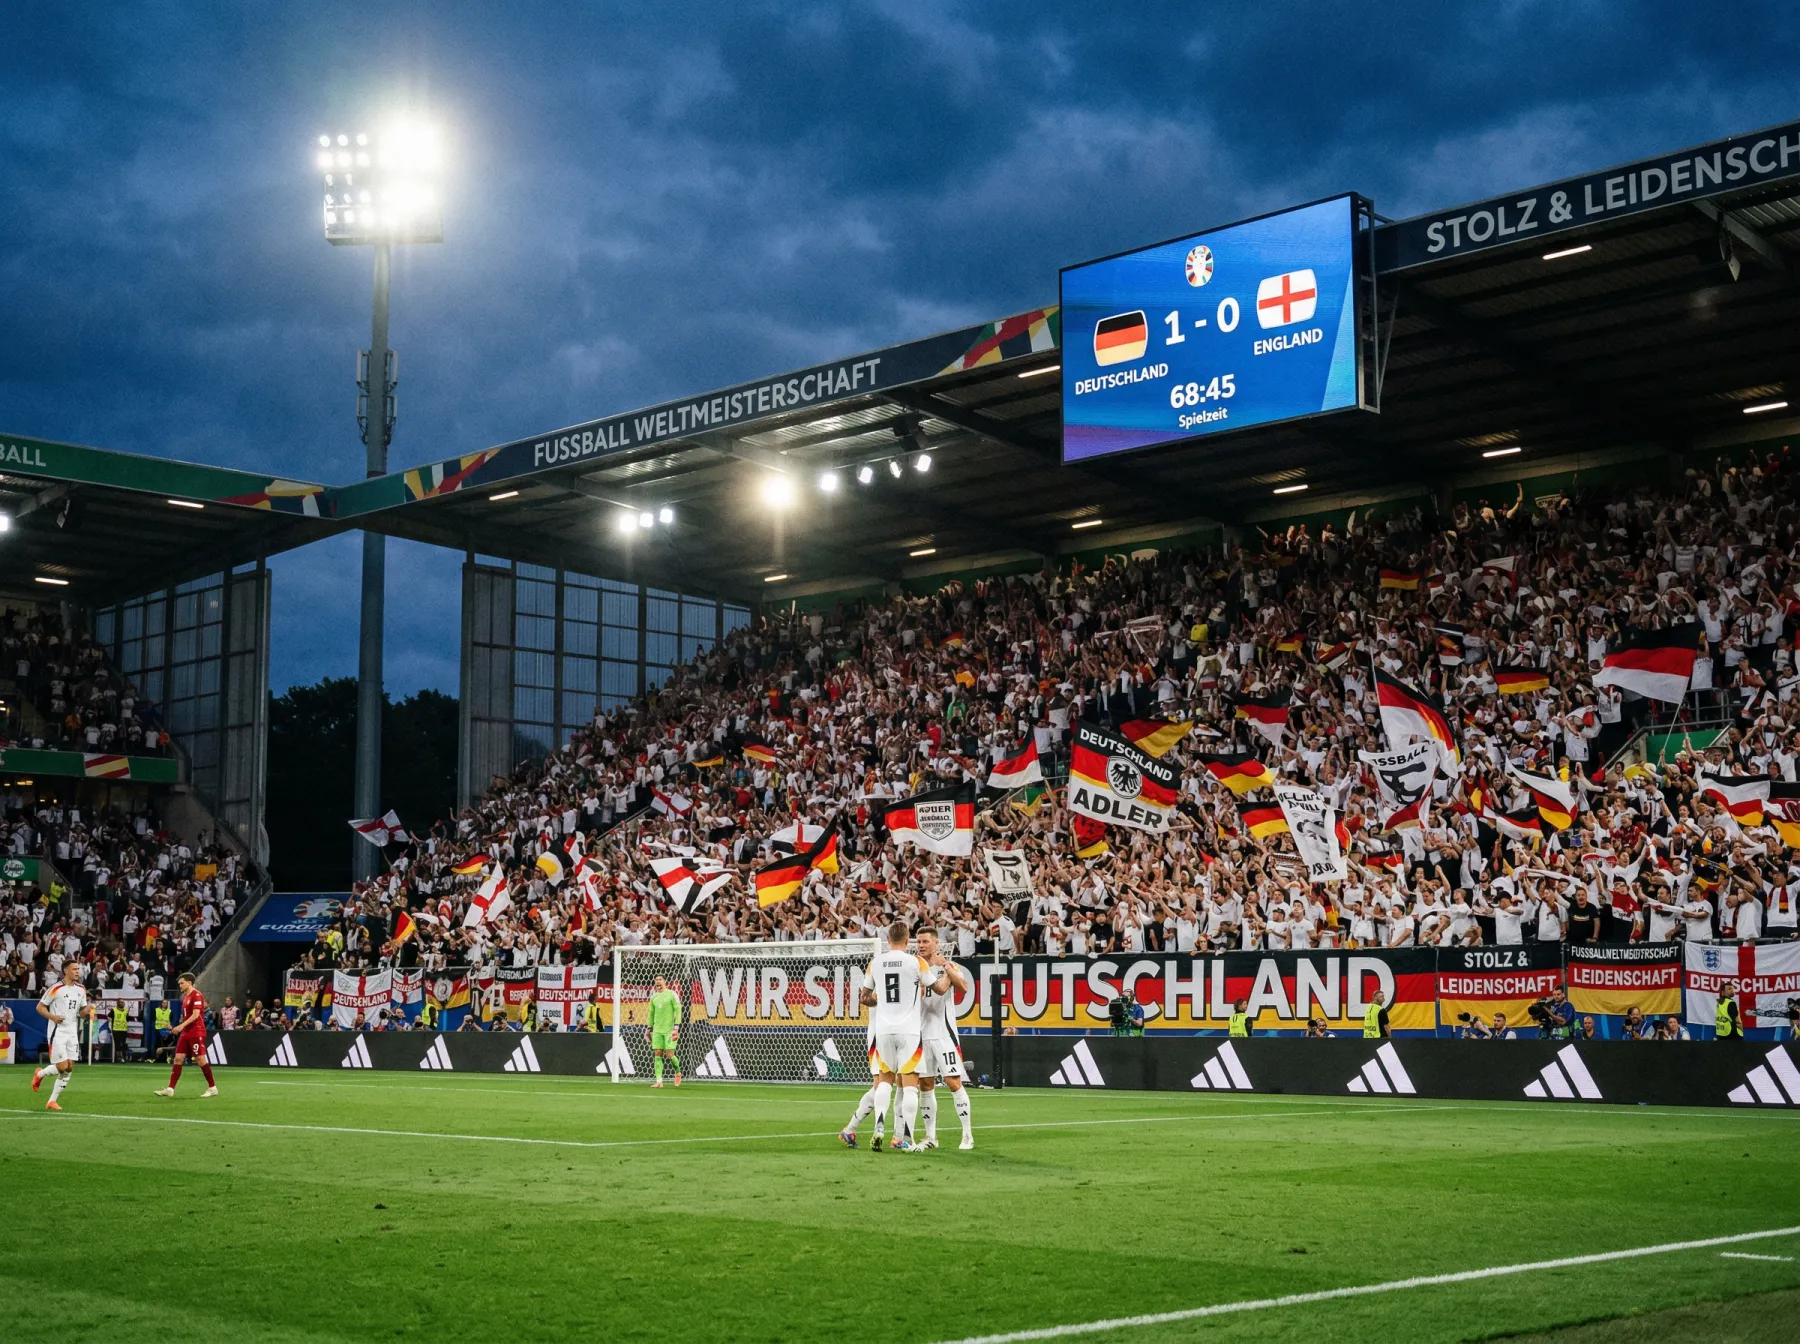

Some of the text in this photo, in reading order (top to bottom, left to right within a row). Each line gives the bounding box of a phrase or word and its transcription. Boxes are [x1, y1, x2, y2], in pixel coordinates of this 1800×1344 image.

[1426, 131, 1800, 253] STOLZ & LEIDENSCH
[1164, 310, 1185, 346] 1
[1216, 297, 1240, 333] 0
[1253, 328, 1323, 355] ENGLAND
[1075, 363, 1169, 395] DEUTSCHLAND
[1170, 374, 1236, 409] 68:45
[534, 357, 881, 467] FUSSBALL WELTMEISTERSCHAFT
[1179, 407, 1228, 430] Spielzeit
[1080, 728, 1173, 781] DEUTSCHLAND
[1073, 788, 1163, 829] ADLER
[1464, 951, 1528, 968] STOLZ &
[1573, 967, 1677, 986] LEIDENSCHAFT
[699, 967, 793, 1019] WIR
[953, 957, 1395, 1021] DEUTSCHLAND
[1439, 975, 1557, 995] LEIDENSCHAFT
